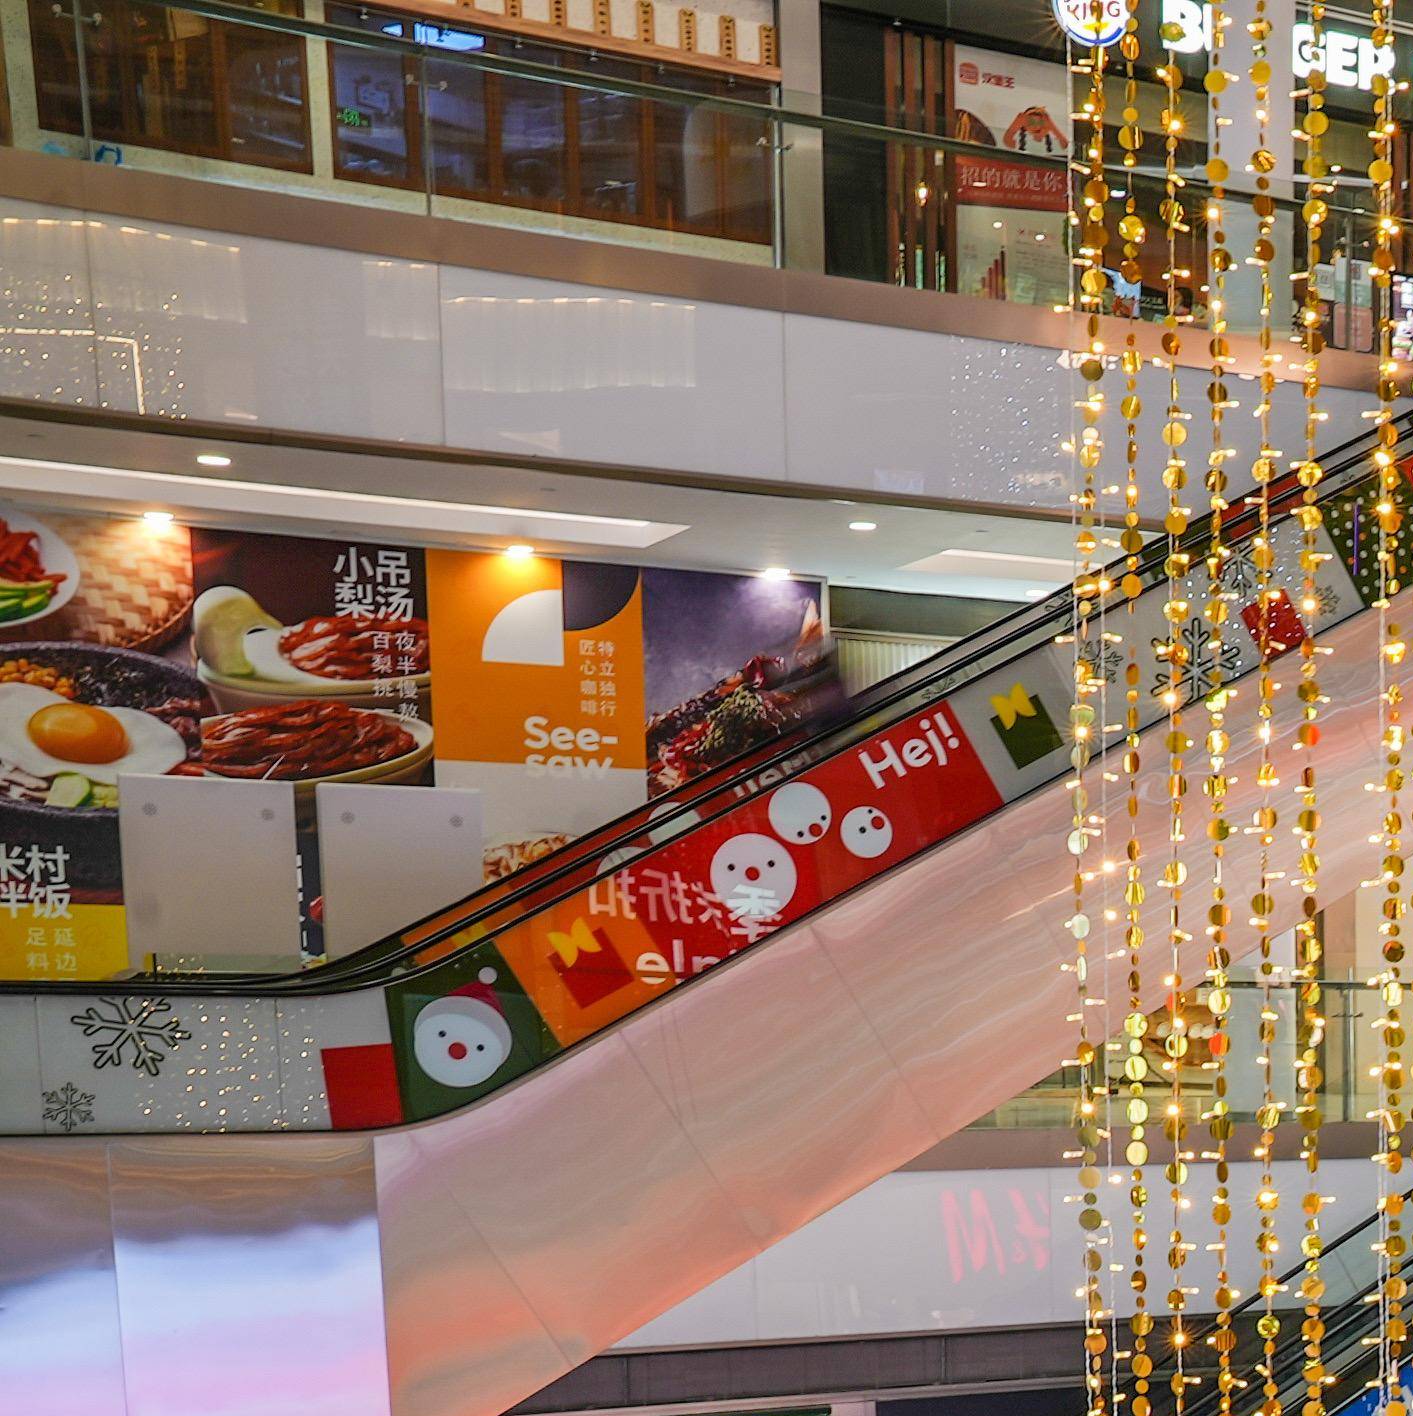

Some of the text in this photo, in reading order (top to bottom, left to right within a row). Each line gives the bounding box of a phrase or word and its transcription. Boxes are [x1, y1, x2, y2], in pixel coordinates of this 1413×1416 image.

[1161, 0, 1397, 90] BGER
[959, 166, 1065, 191] 招的就是你
[524, 716, 619, 752] See-
[858, 712, 960, 790] Hej!
[26, 927, 49, 981] 足料
[54, 927, 78, 981] 延边
